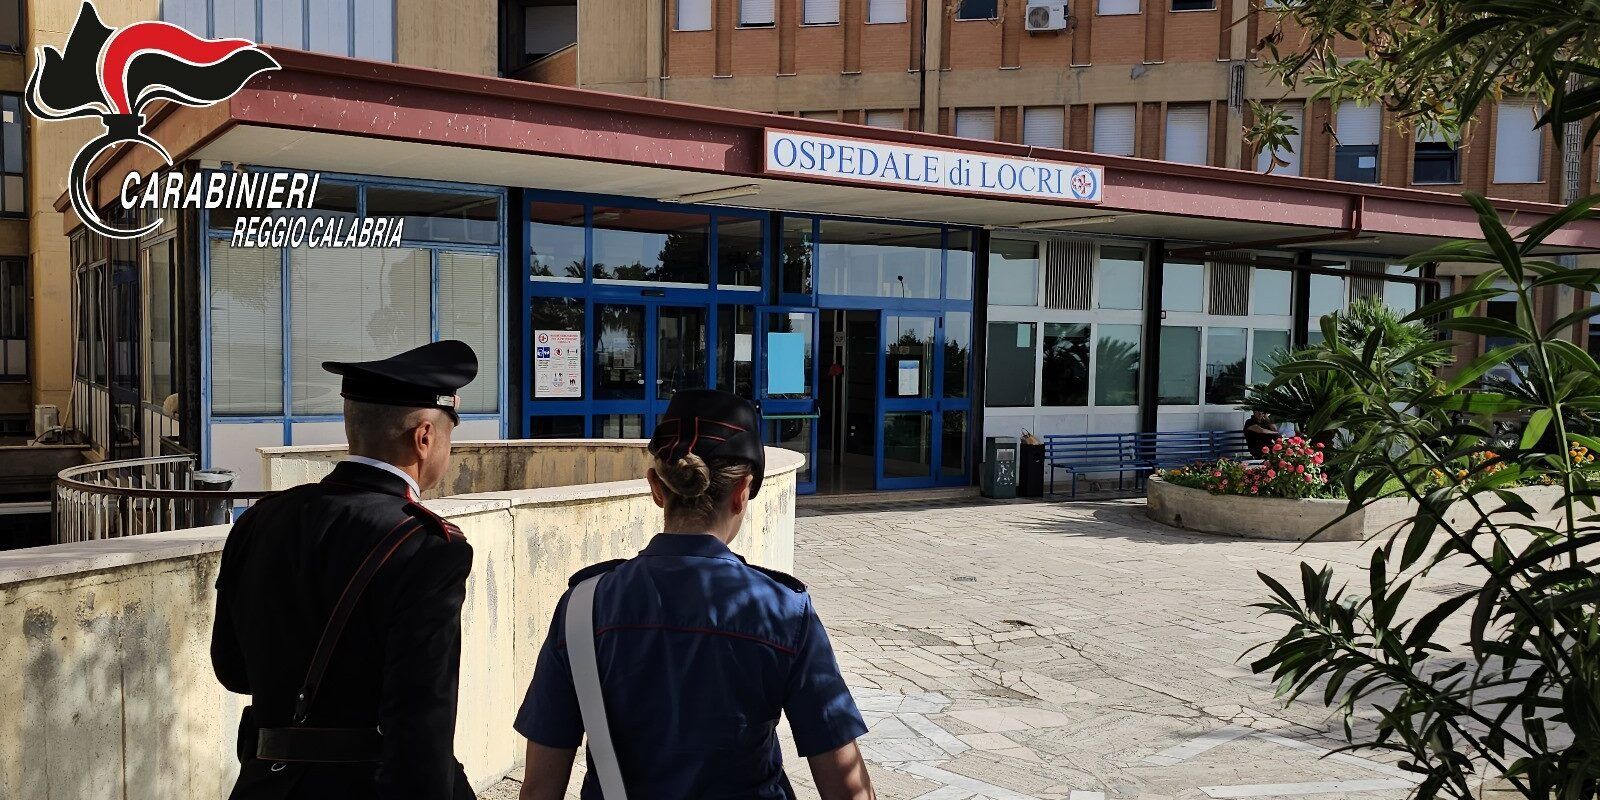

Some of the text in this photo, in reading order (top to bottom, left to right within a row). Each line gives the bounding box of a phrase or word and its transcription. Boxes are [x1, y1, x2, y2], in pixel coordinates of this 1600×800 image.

[773, 138, 1064, 194] OSPEDALE di LOCRI
